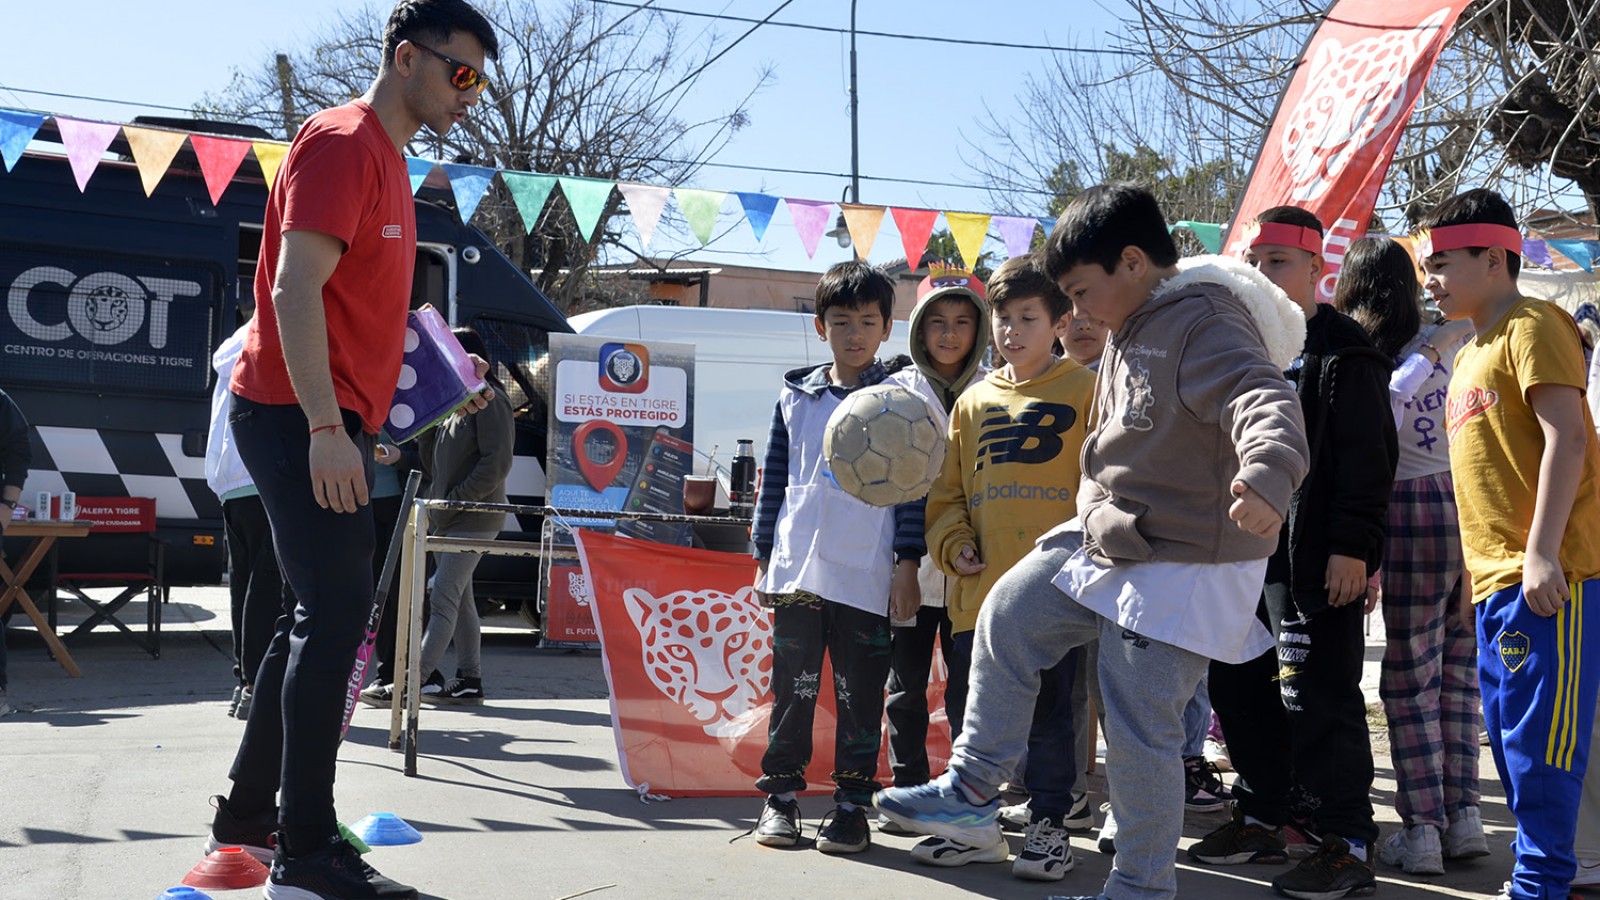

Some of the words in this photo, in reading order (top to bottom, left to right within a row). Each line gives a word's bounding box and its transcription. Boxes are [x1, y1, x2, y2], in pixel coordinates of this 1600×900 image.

[7, 266, 202, 349] COT
[5, 345, 54, 357] CENTRO
[58, 349, 74, 359] DE
[77, 351, 156, 365] OPERACIONES
[160, 356, 193, 367] TIGRE
[564, 394, 576, 404] SI
[579, 394, 617, 407] ESTÁS
[621, 397, 638, 408] EN
[564, 404, 603, 417] ESTÁS
[606, 409, 678, 421] PROTEGIDO
[987, 480, 1070, 501] balance
[604, 497, 610, 505] A
[116, 507, 140, 515] TIGRE
[1132, 640, 1149, 649] AIR
[1279, 632, 1311, 644] NIKE
[1279, 647, 1309, 662] NIKE
[1502, 647, 1525, 655] CABJ
